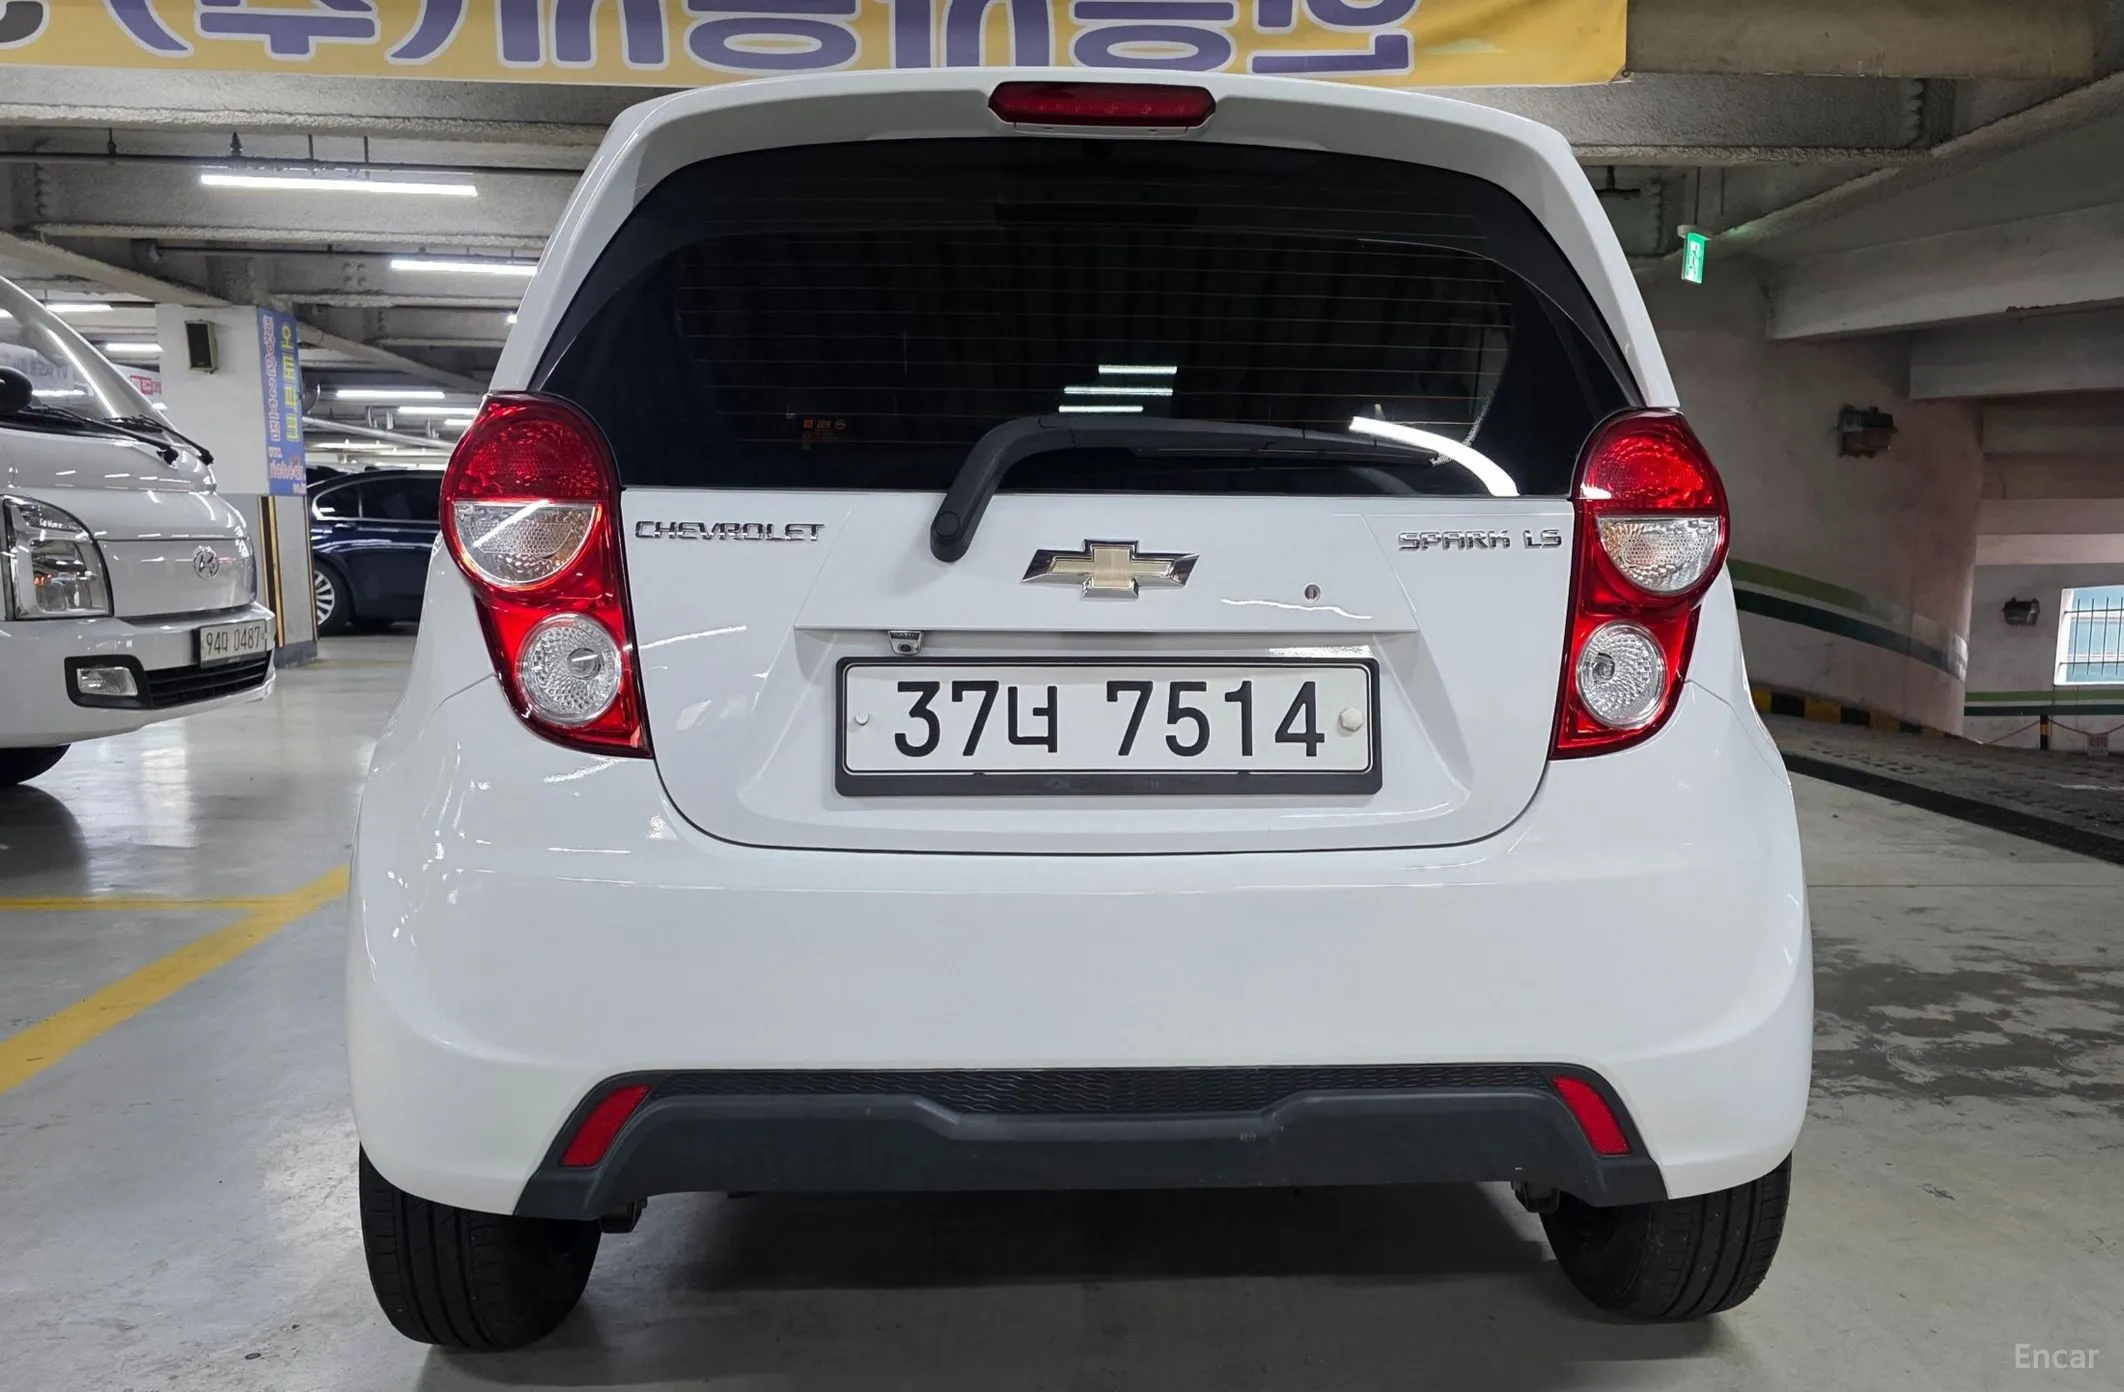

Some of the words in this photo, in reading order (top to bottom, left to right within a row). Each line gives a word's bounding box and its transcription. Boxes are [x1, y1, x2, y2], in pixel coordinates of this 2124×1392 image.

[635, 520, 825, 541] CHEVROLET
[1399, 530, 1511, 551] SPARK
[1523, 529, 1562, 549] LS
[233, 626, 261, 651] 0487
[894, 680, 1058, 757] 37너
[1106, 680, 1326, 757] 7514
